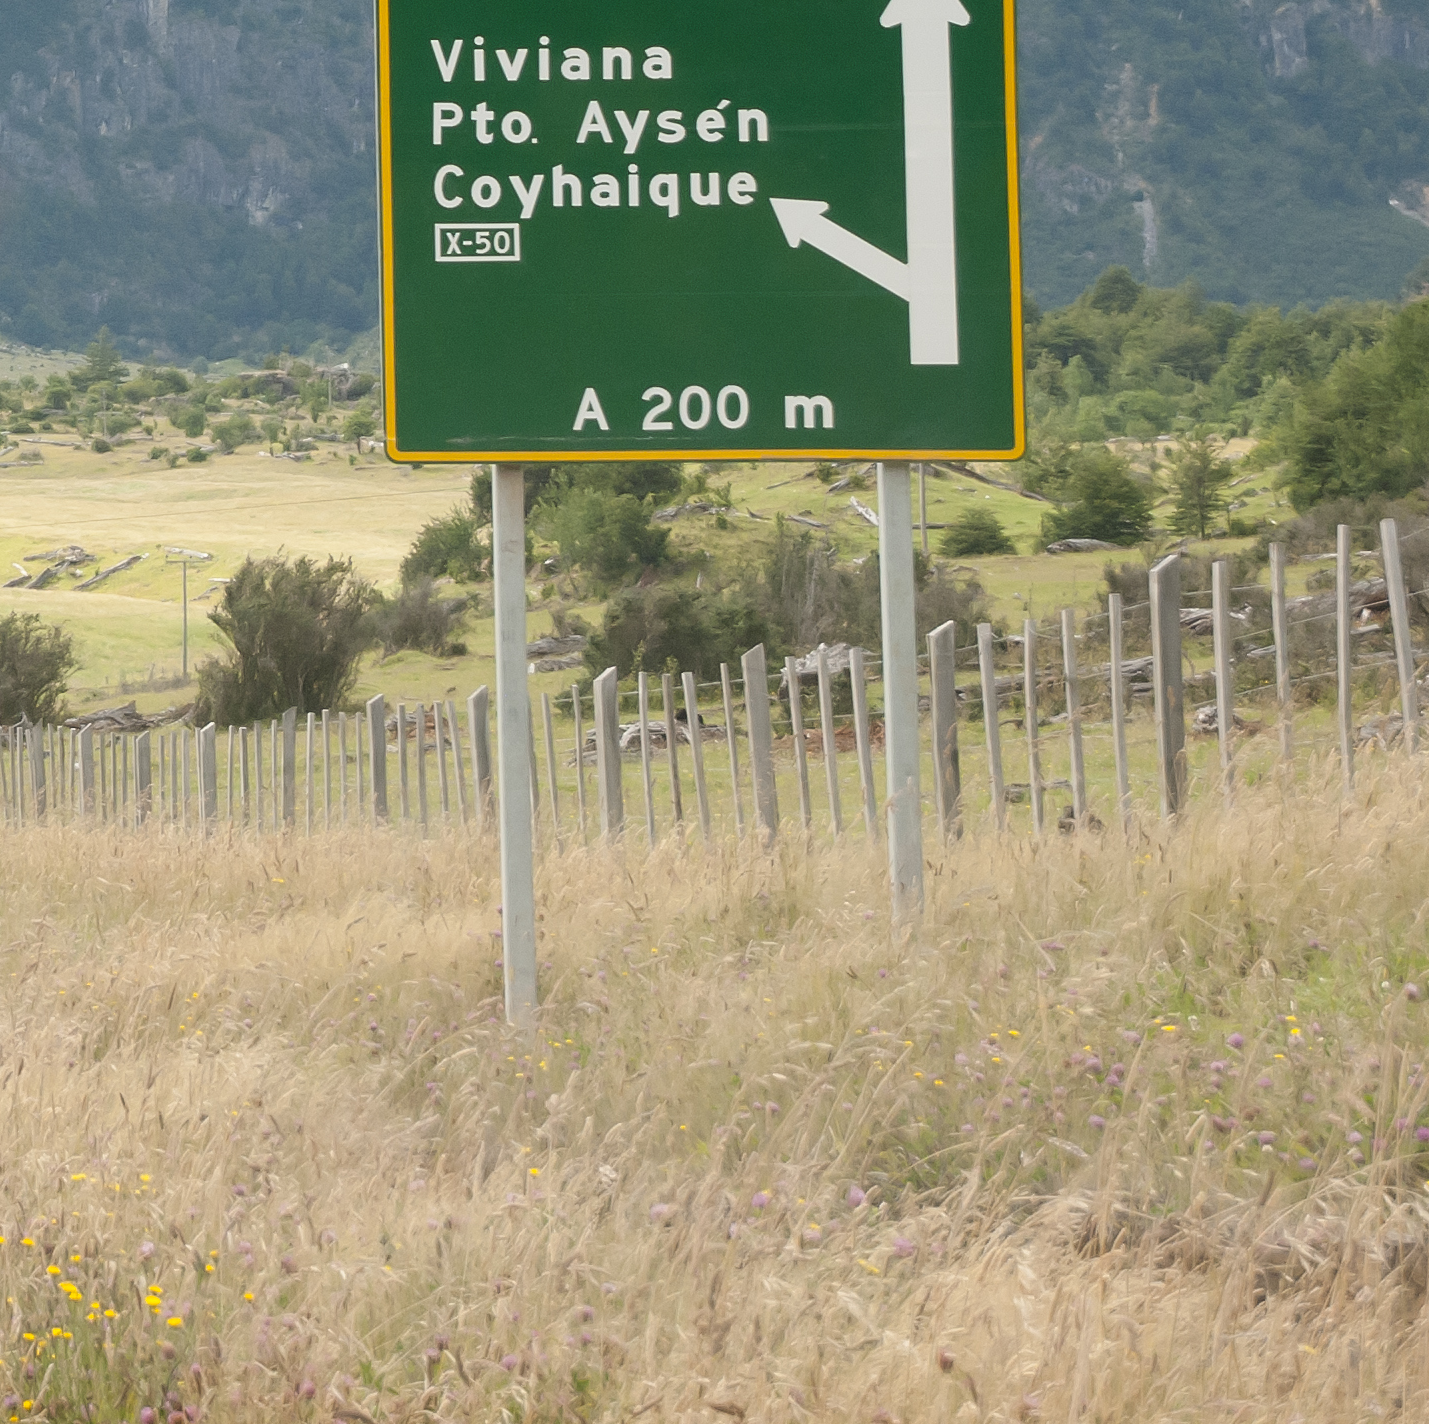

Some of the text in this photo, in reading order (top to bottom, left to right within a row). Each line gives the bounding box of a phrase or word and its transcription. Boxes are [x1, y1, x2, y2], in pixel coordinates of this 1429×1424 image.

[430, 35, 673, 82] Viviana
[433, 99, 769, 154] Pto. Aysén
[434, 163, 758, 219] Coyhaique
[445, 229, 511, 256] X-50
[572, 384, 834, 431] A 200 m
